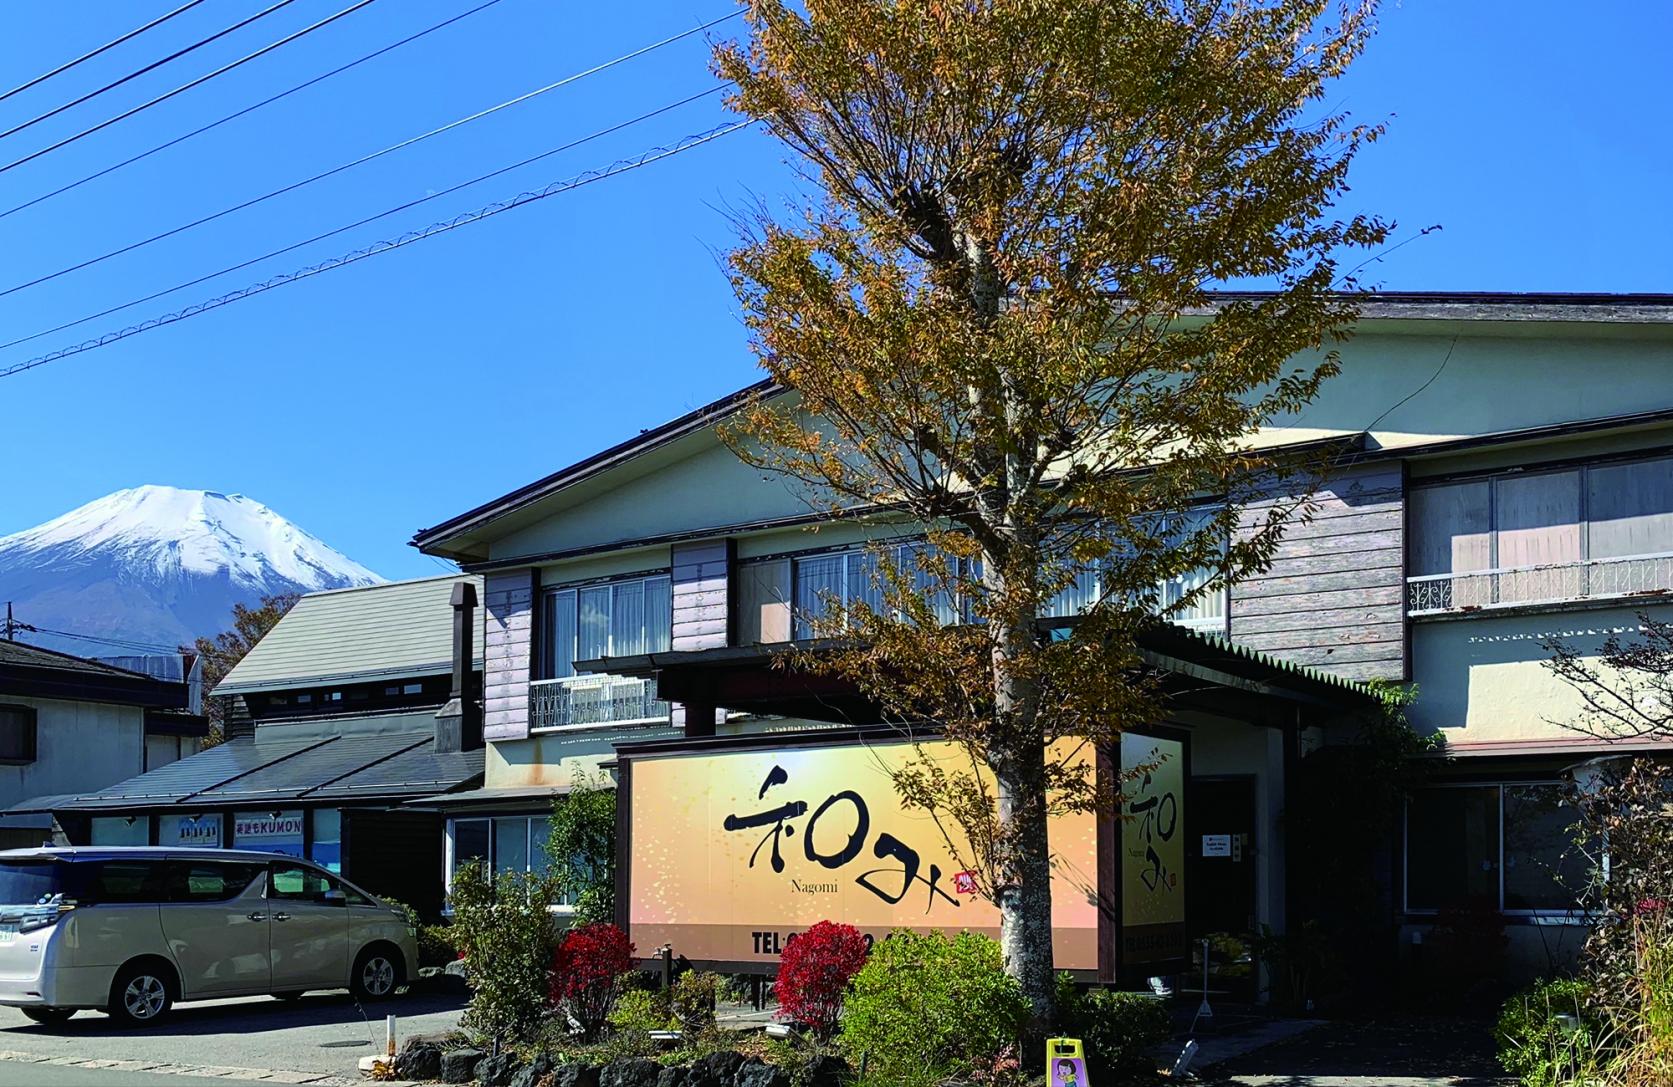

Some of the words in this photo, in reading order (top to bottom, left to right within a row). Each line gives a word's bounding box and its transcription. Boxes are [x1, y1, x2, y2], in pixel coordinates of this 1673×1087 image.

[724, 765, 960, 915] 和み
[791, 878, 838, 896] Nagomi
[1130, 773, 1176, 892] 和み
